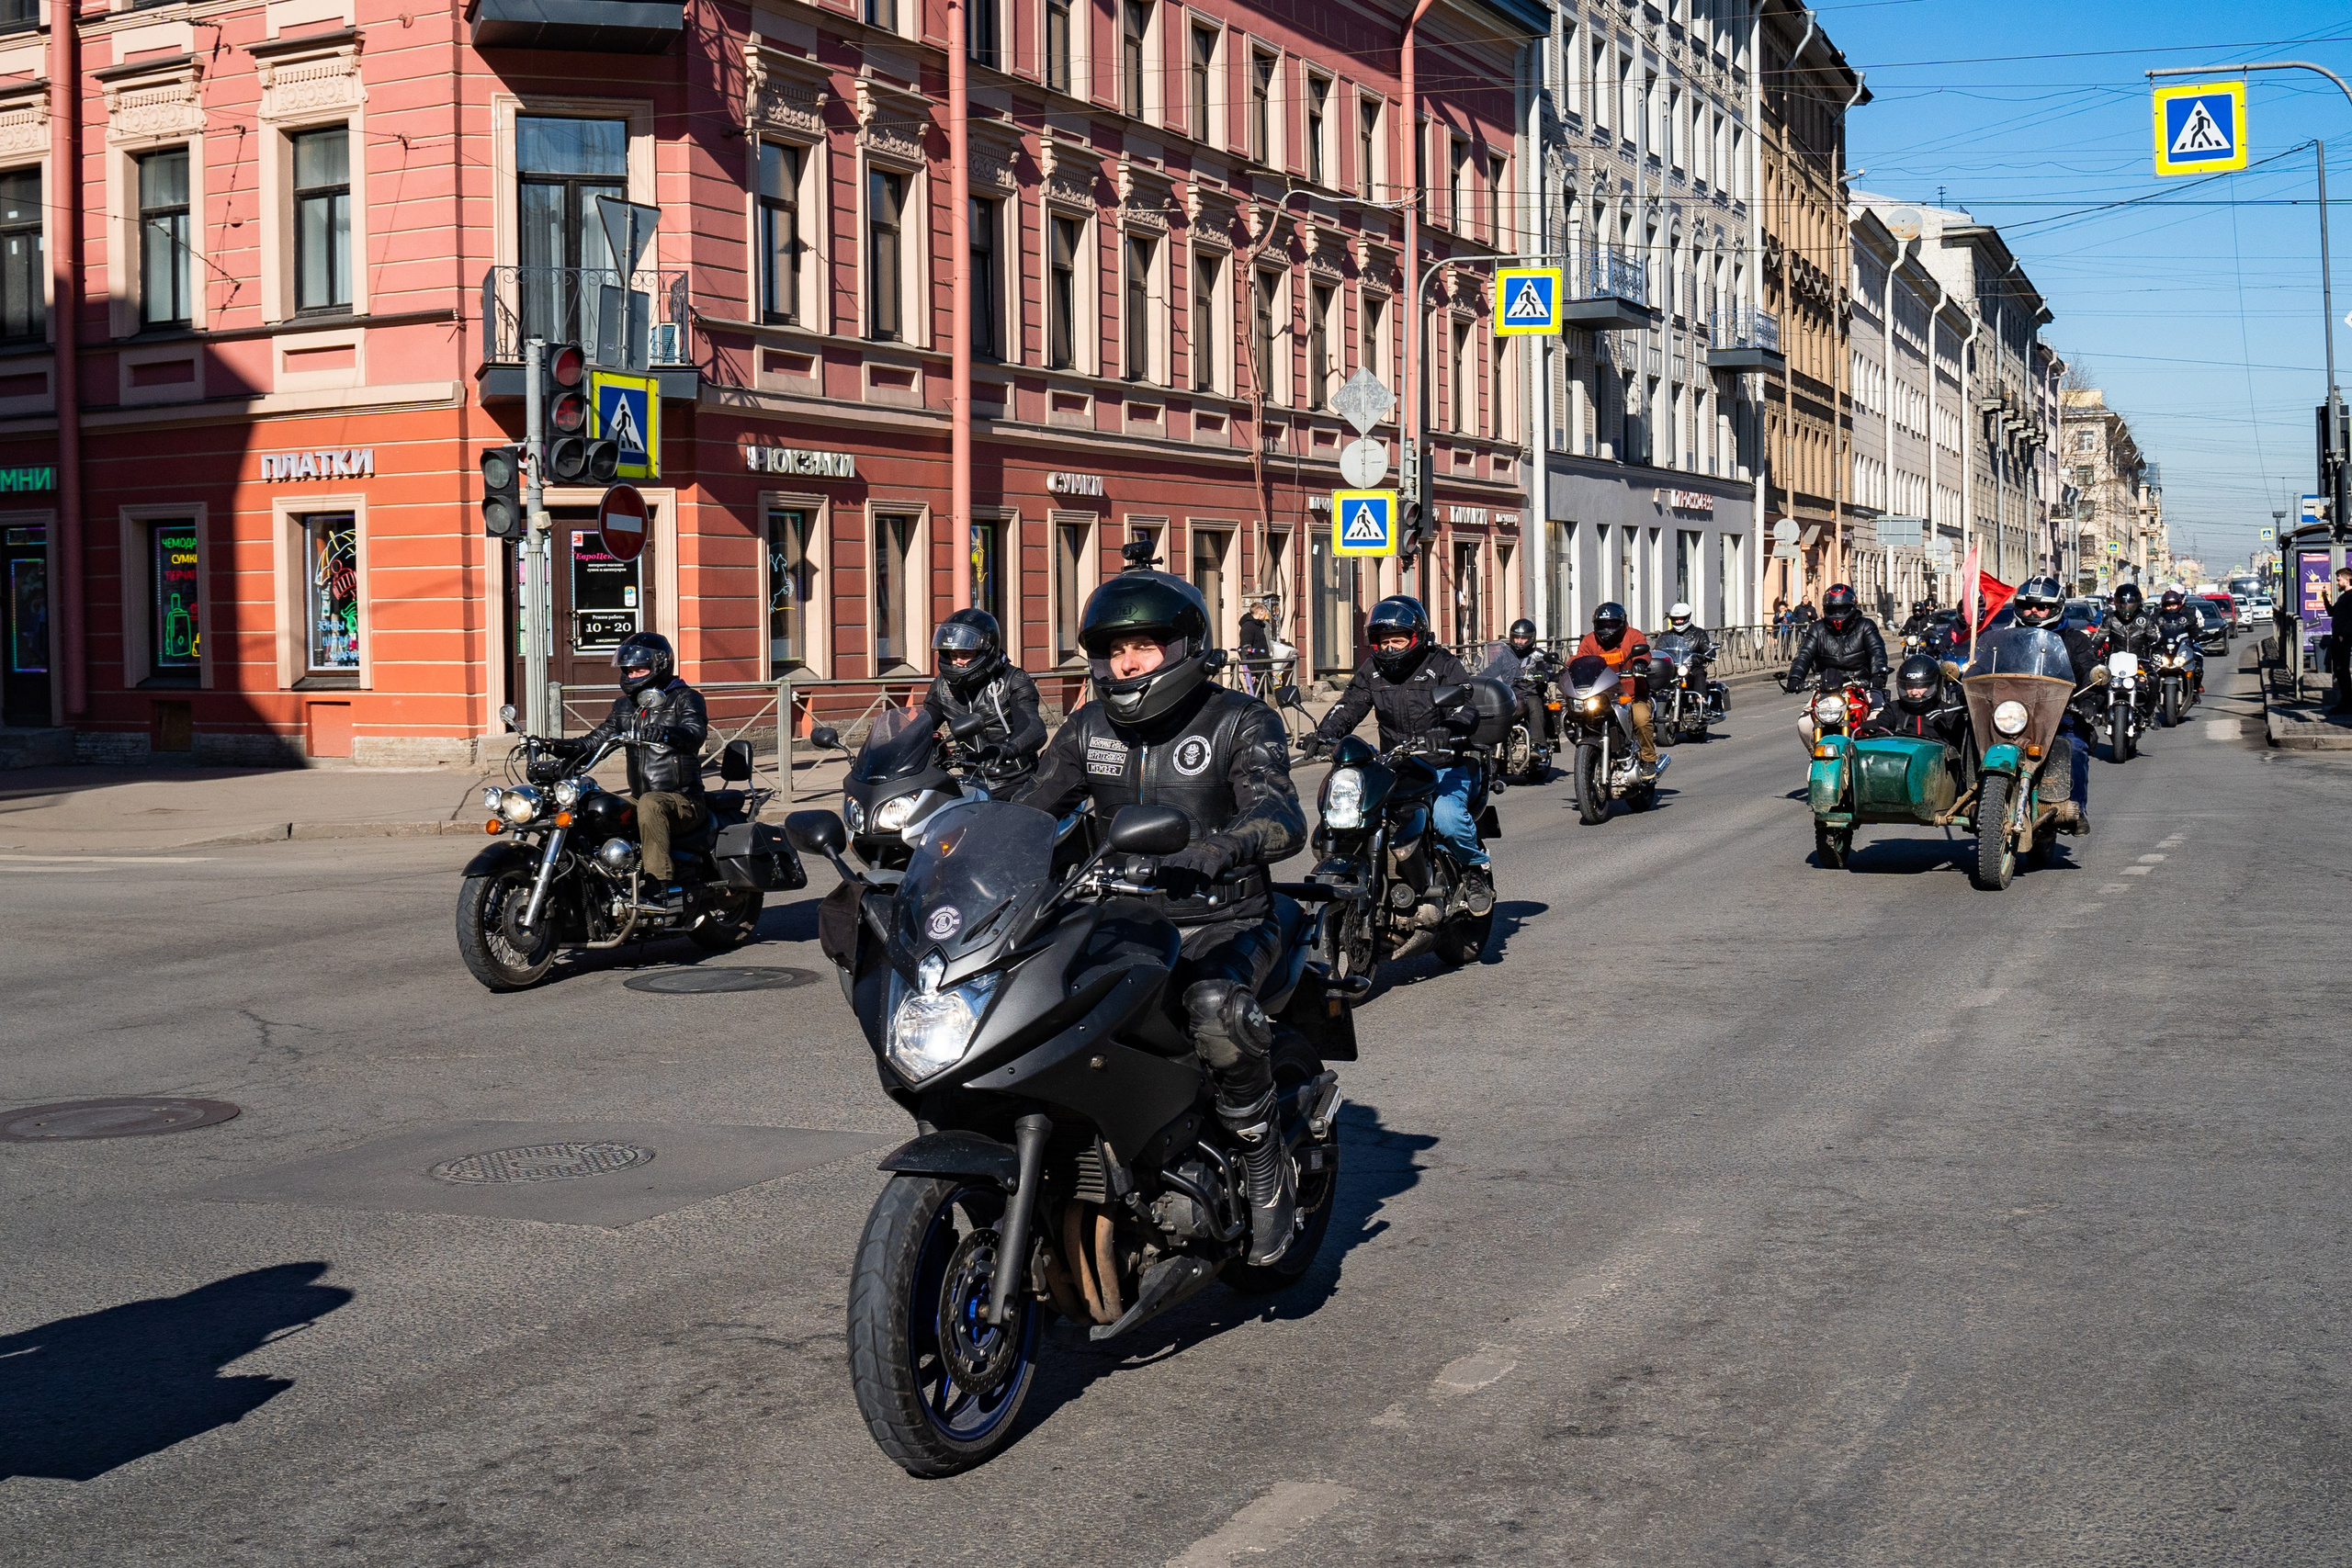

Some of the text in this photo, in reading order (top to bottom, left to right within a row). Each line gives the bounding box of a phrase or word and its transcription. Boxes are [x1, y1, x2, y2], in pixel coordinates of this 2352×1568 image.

[261, 448, 374, 480] ПЛАТКИ
[747, 446, 855, 478] РЮКЗАКИ
[1046, 471, 1103, 496] СУМКИ
[585, 623, 602, 633] 10
[614, 622, 631, 632] 20
